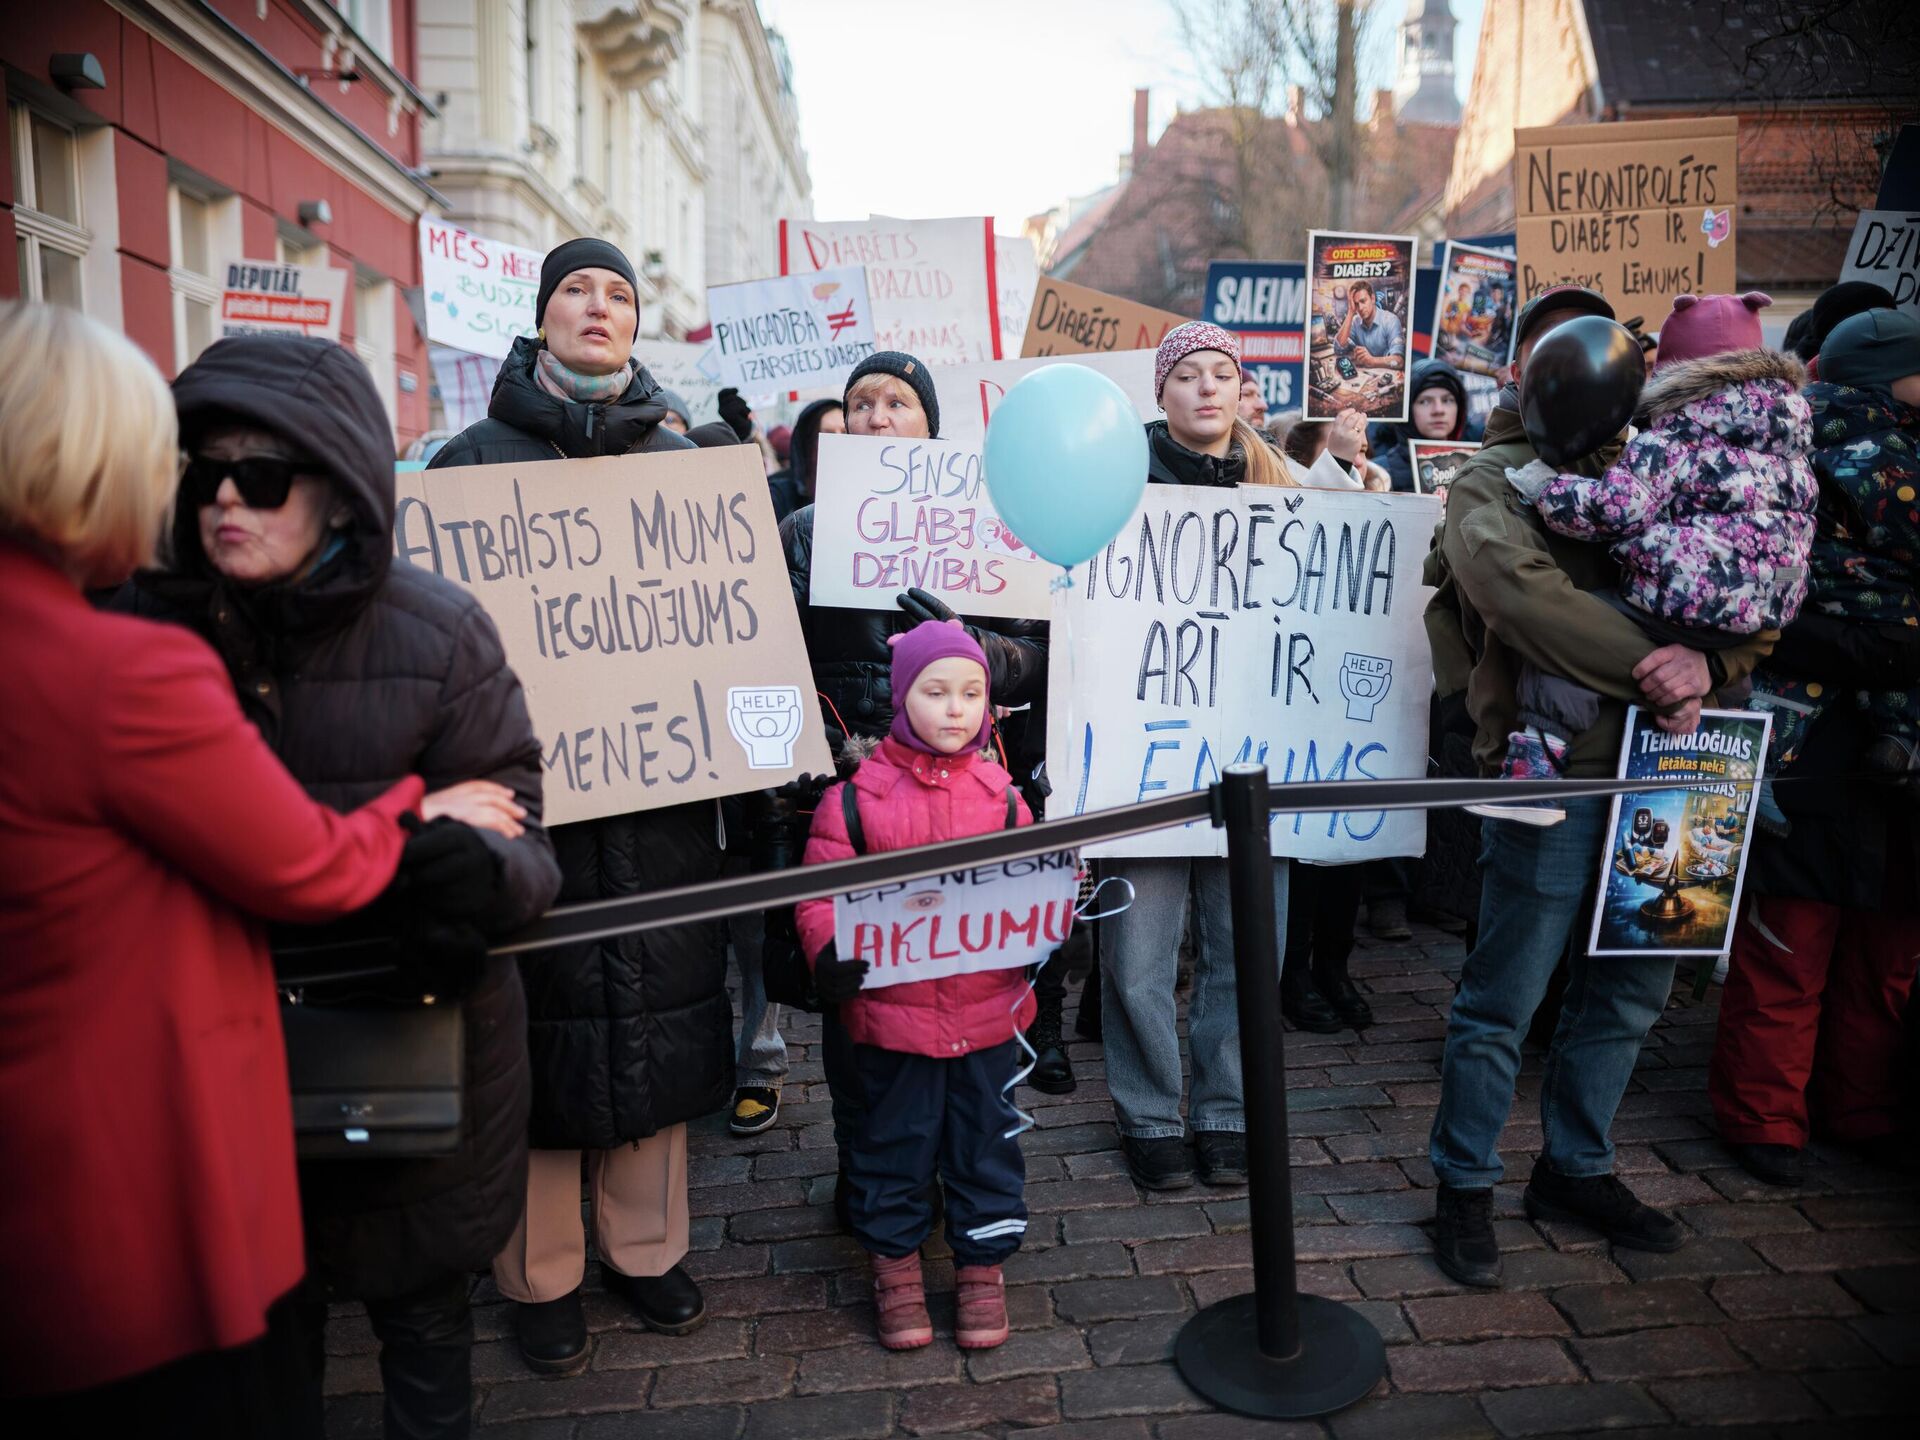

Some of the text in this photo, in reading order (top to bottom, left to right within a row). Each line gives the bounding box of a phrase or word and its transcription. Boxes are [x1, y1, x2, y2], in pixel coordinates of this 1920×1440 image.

[1528, 147, 1718, 213] NEKONTROLĒTS
[429, 227, 542, 283] MĒS NEE
[803, 229, 918, 270] DIABĒTS
[1332, 249, 1355, 259] OTRS
[1357, 248, 1387, 259] DARBS
[1551, 210, 1640, 253] DIABĒTS
[869, 260, 953, 300] PAZŪD
[1333, 261, 1392, 277] DIABĒTS?
[1036, 288, 1120, 350] DIABĒTS
[1214, 275, 1305, 325] SAEIM
[715, 307, 820, 355] PILNGADĪBA
[630, 490, 756, 570] MUMS
[1137, 611, 1230, 707] ARĪ
[1351, 657, 1384, 673] HELP
[743, 695, 786, 708] HELP
[540, 680, 719, 792] MENĒS!
[1658, 756, 1726, 774] lētākas nekā
[854, 898, 1075, 968] AKLUMU
